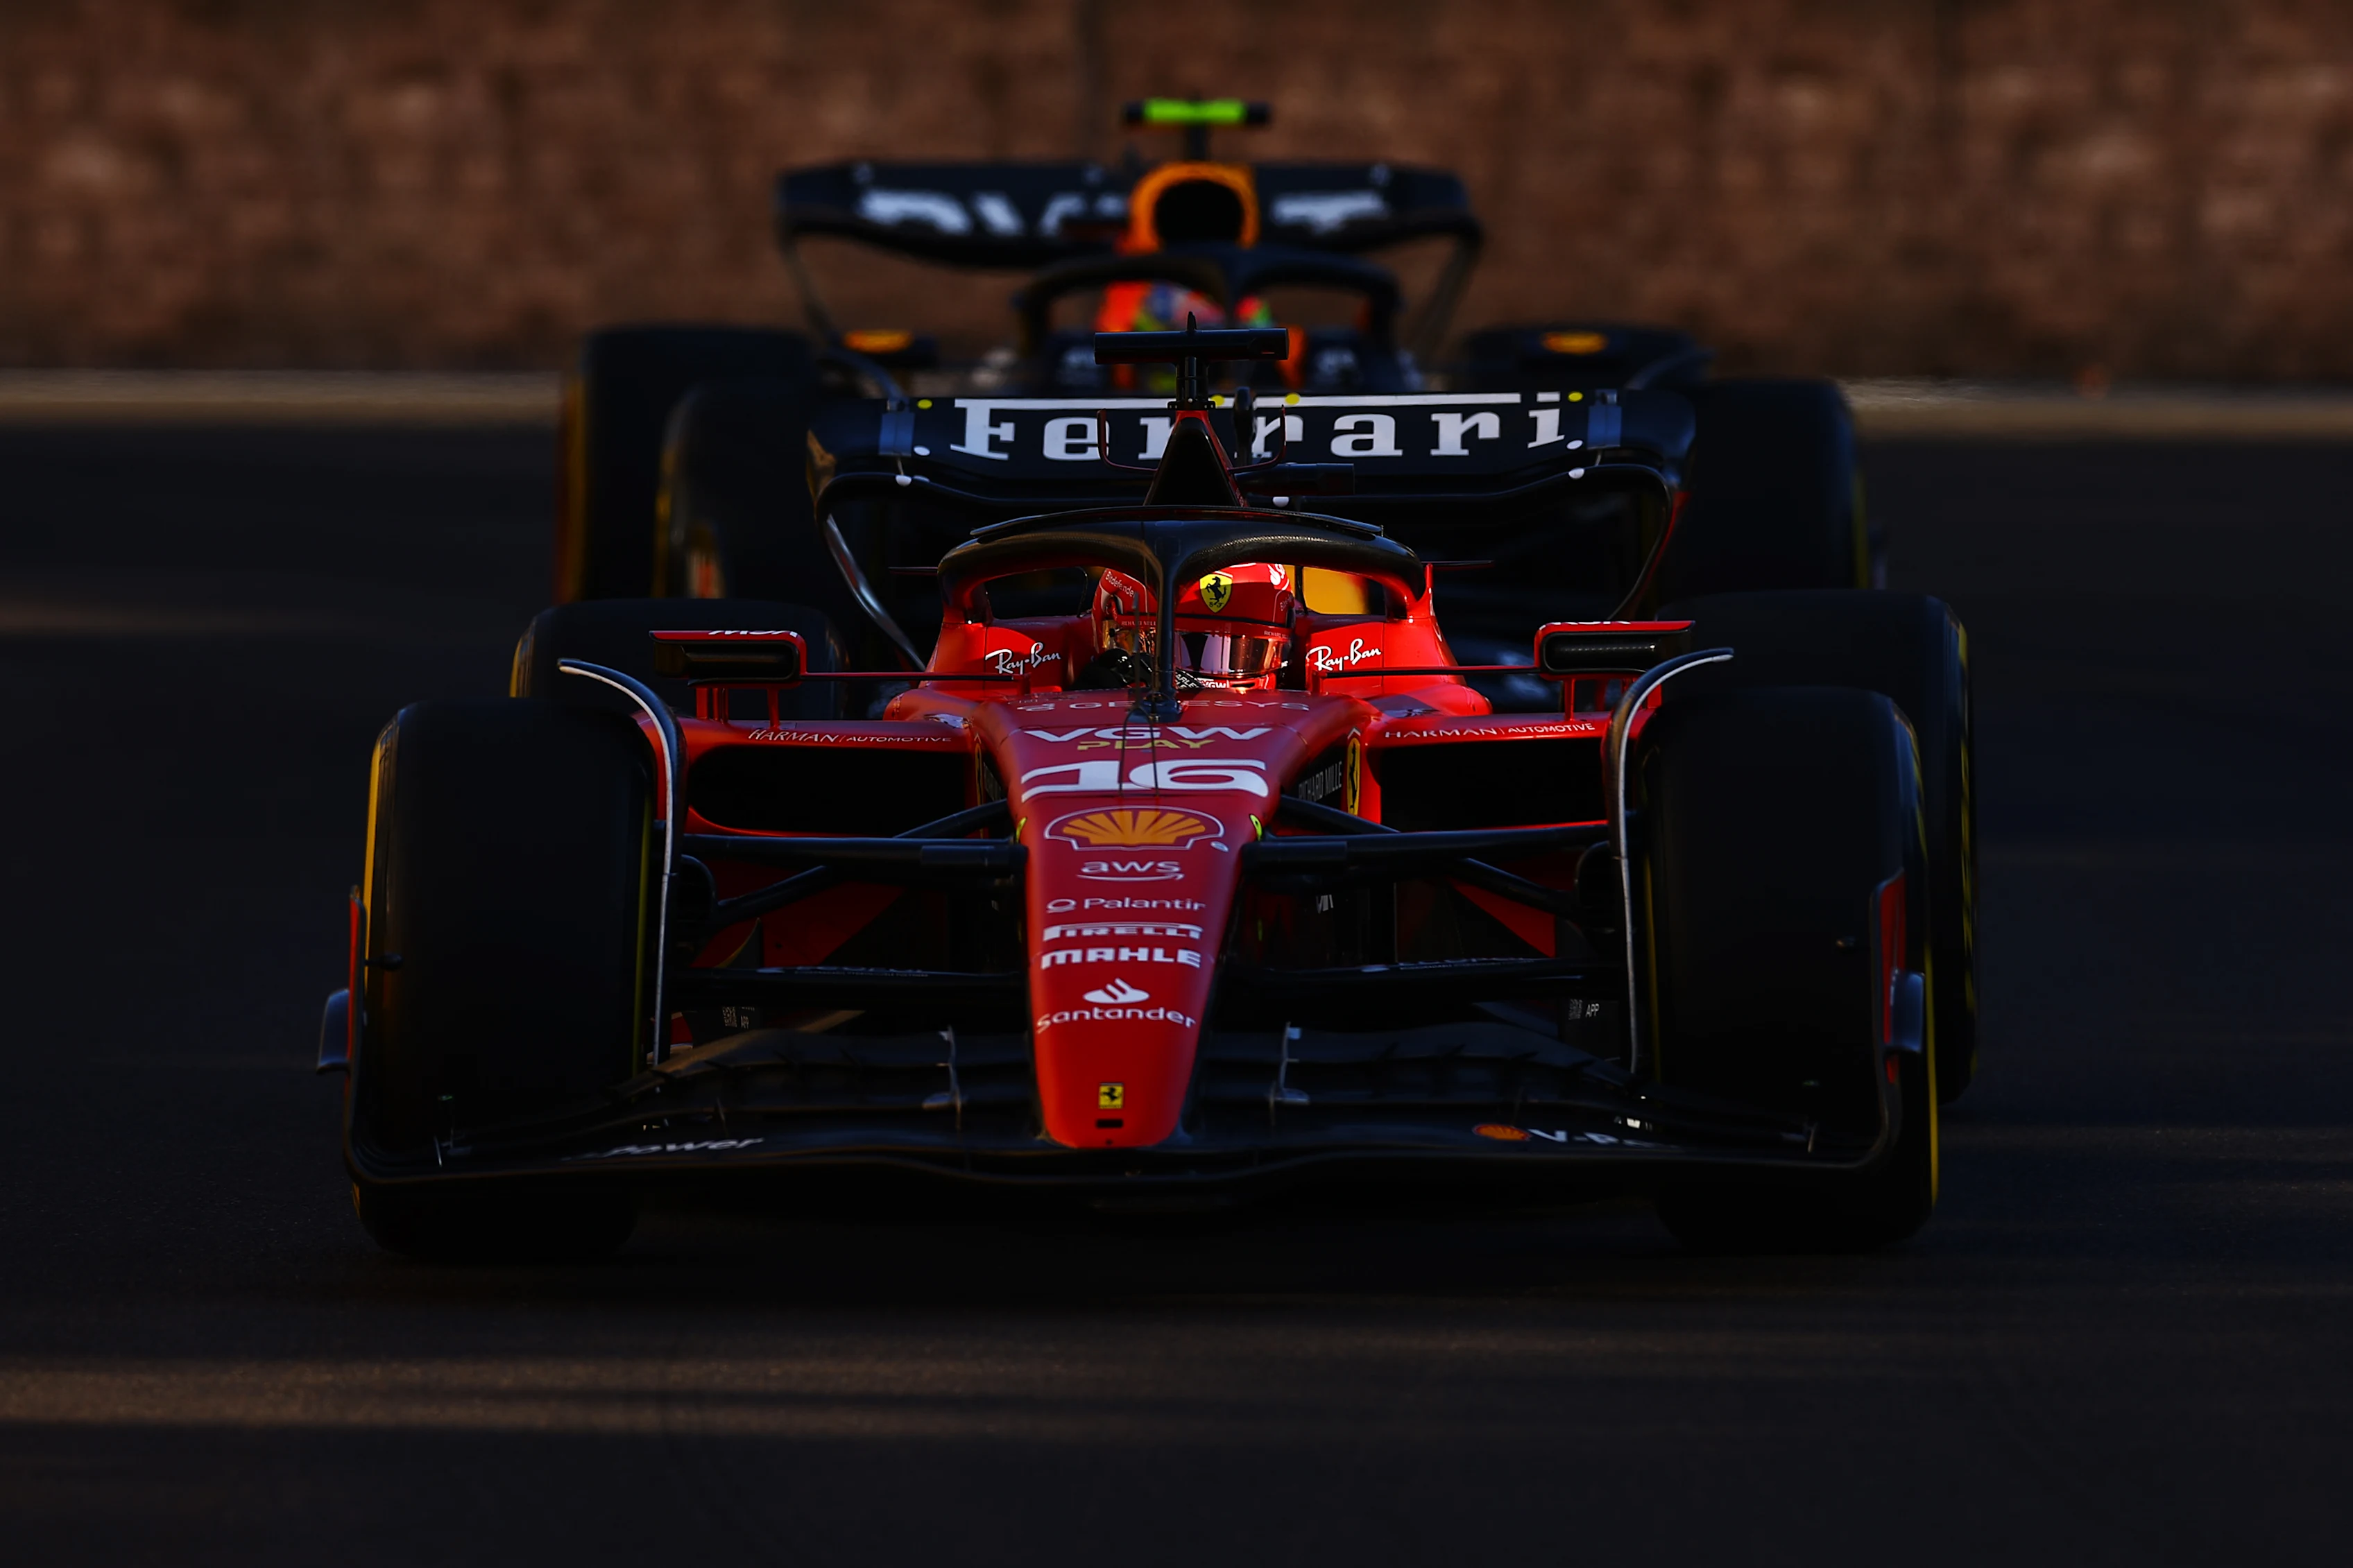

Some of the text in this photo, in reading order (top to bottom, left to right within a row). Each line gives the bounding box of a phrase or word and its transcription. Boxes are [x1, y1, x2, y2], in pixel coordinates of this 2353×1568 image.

[985, 641, 1062, 676] Ray-Ban
[1306, 637, 1382, 673] Ray-Ban
[1068, 700, 1310, 712] GEESYS
[748, 729, 839, 743] HARMAN
[1023, 725, 1274, 743] VGW
[1385, 723, 1595, 739] HARMAN AUTOMOTIVE
[1076, 739, 1216, 751] PLAY
[1020, 758, 1269, 803] 16
[1079, 860, 1181, 874] aws
[1083, 897, 1206, 912] Palantir
[1042, 921, 1204, 942] PIRELLI
[1041, 946, 1202, 970] MAHLE
[1036, 1006, 1196, 1035] Santander
